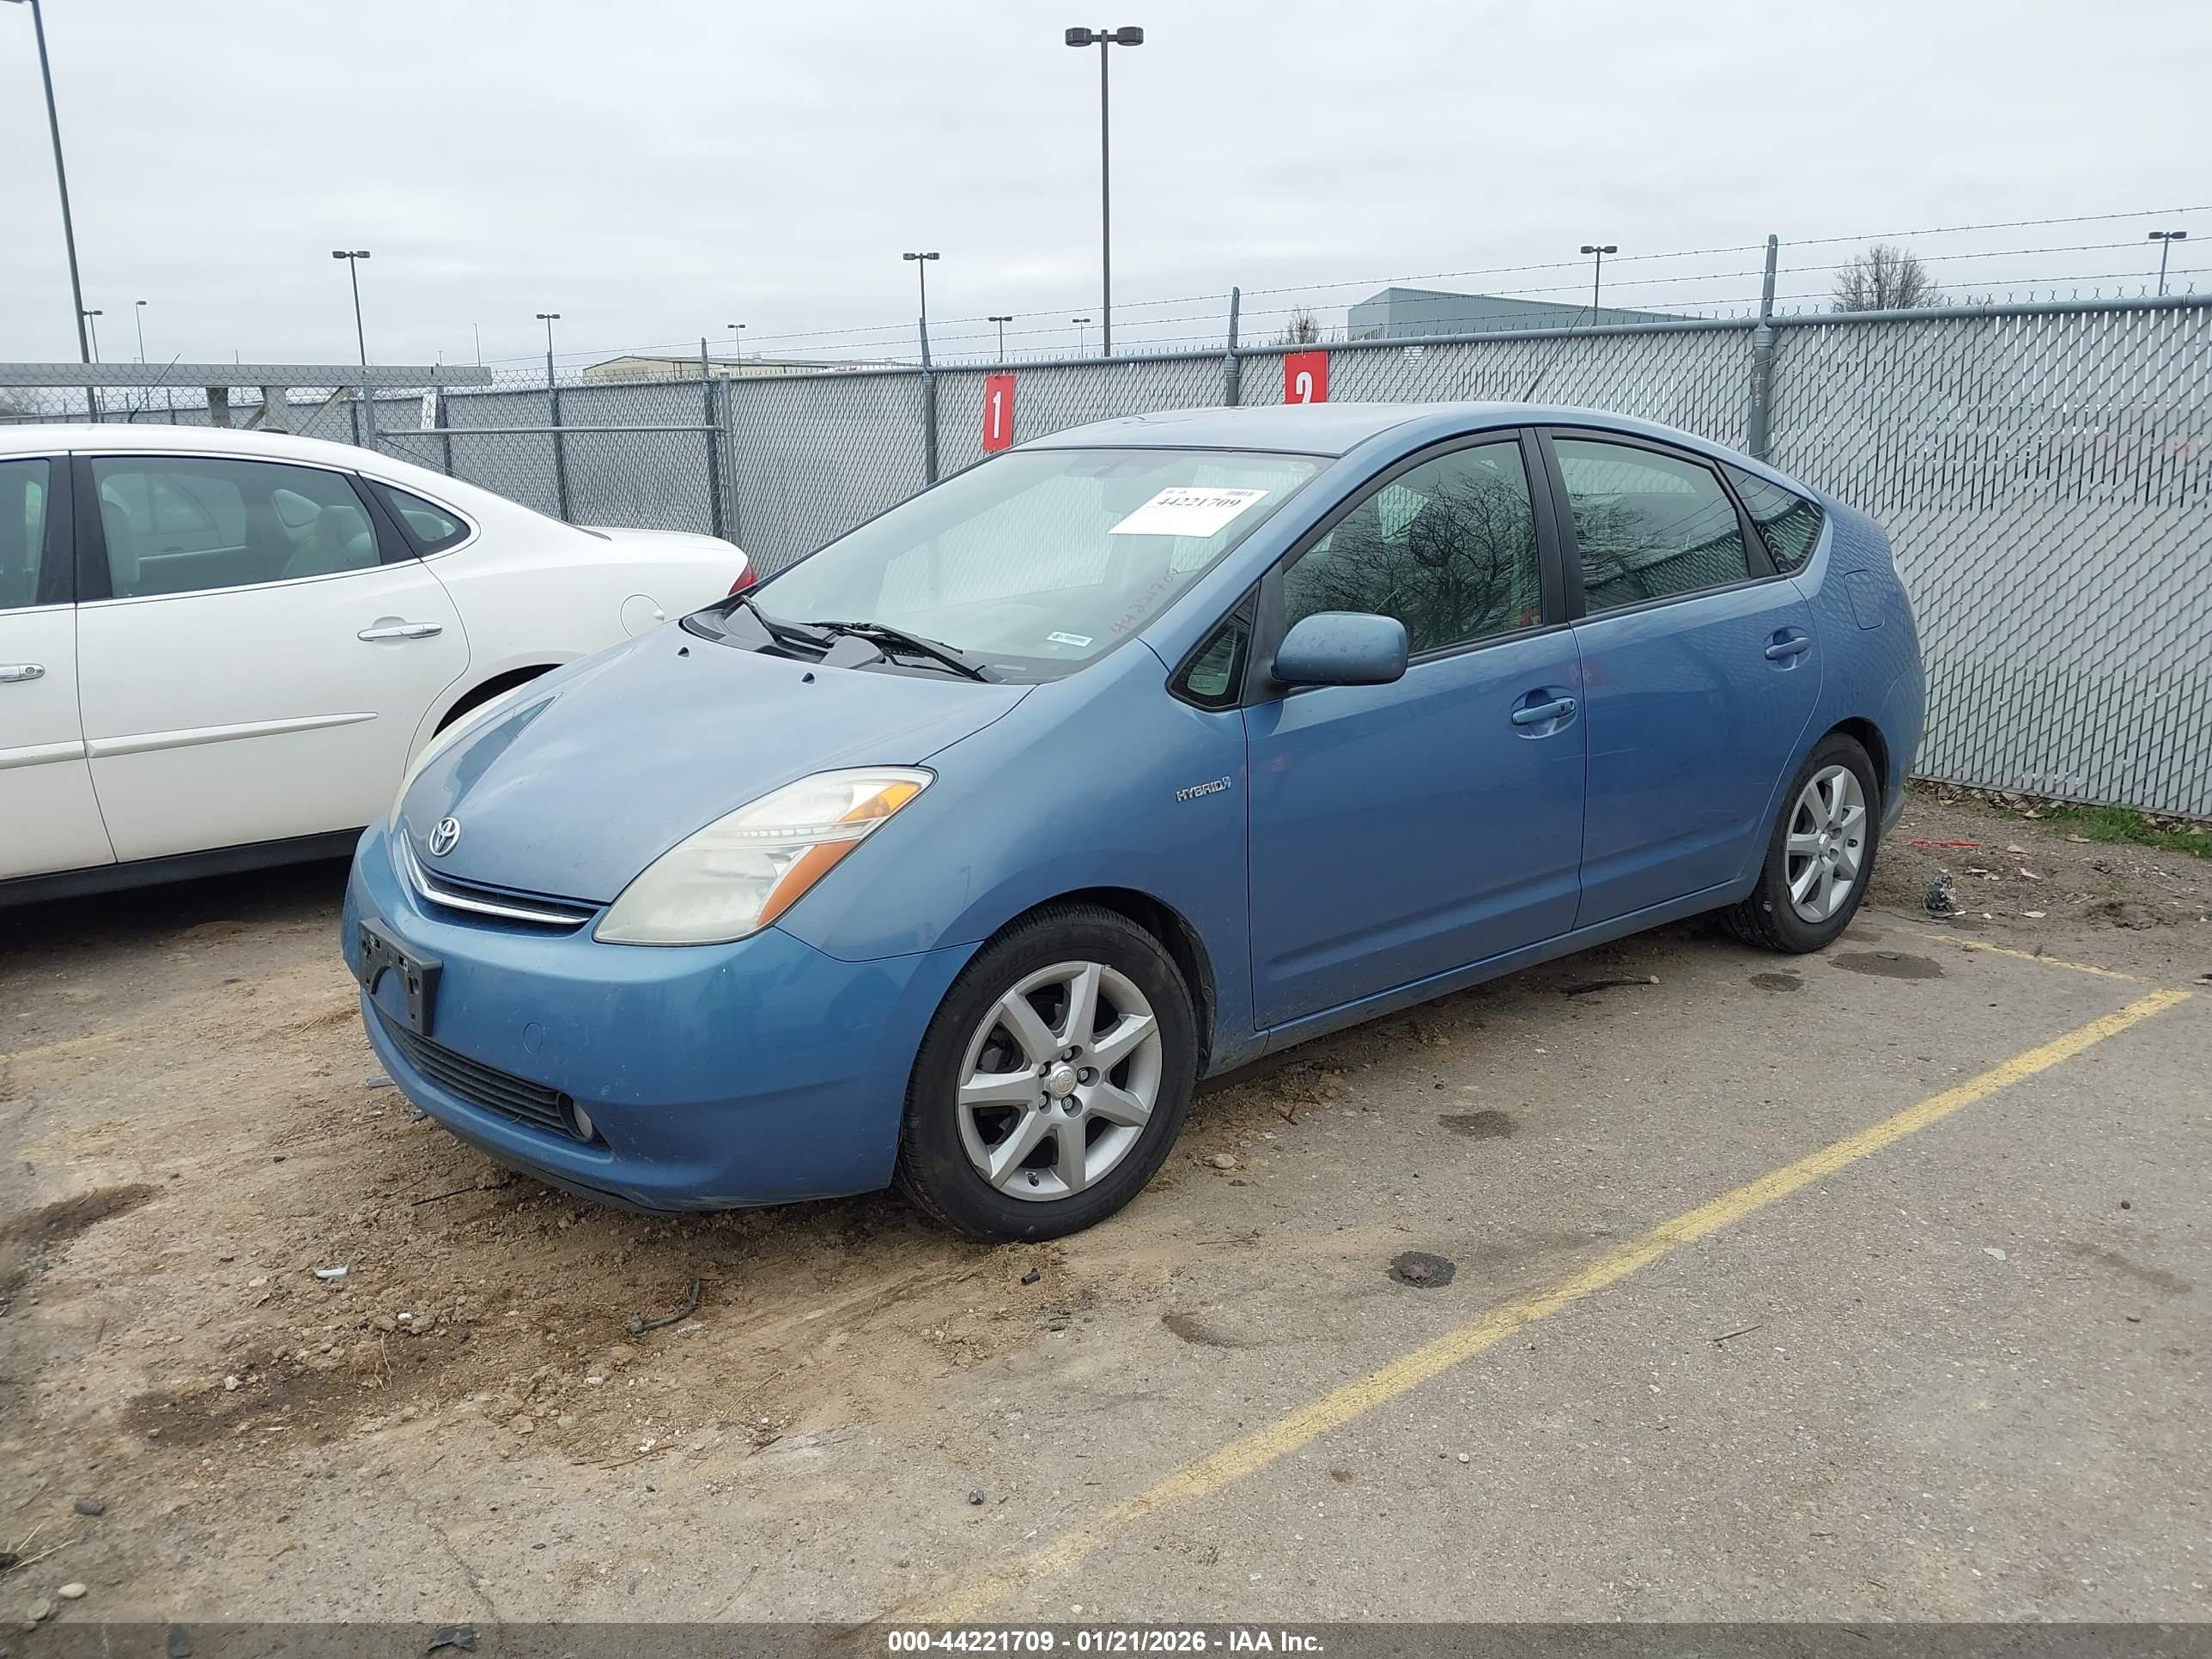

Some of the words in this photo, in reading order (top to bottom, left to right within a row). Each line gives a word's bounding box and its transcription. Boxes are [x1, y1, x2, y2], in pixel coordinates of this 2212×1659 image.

[1296, 372, 1313, 404] 2
[993, 391, 1001, 439] 1
[1156, 497, 1242, 508] 44221709
[1176, 781, 1225, 802] HYBRID
